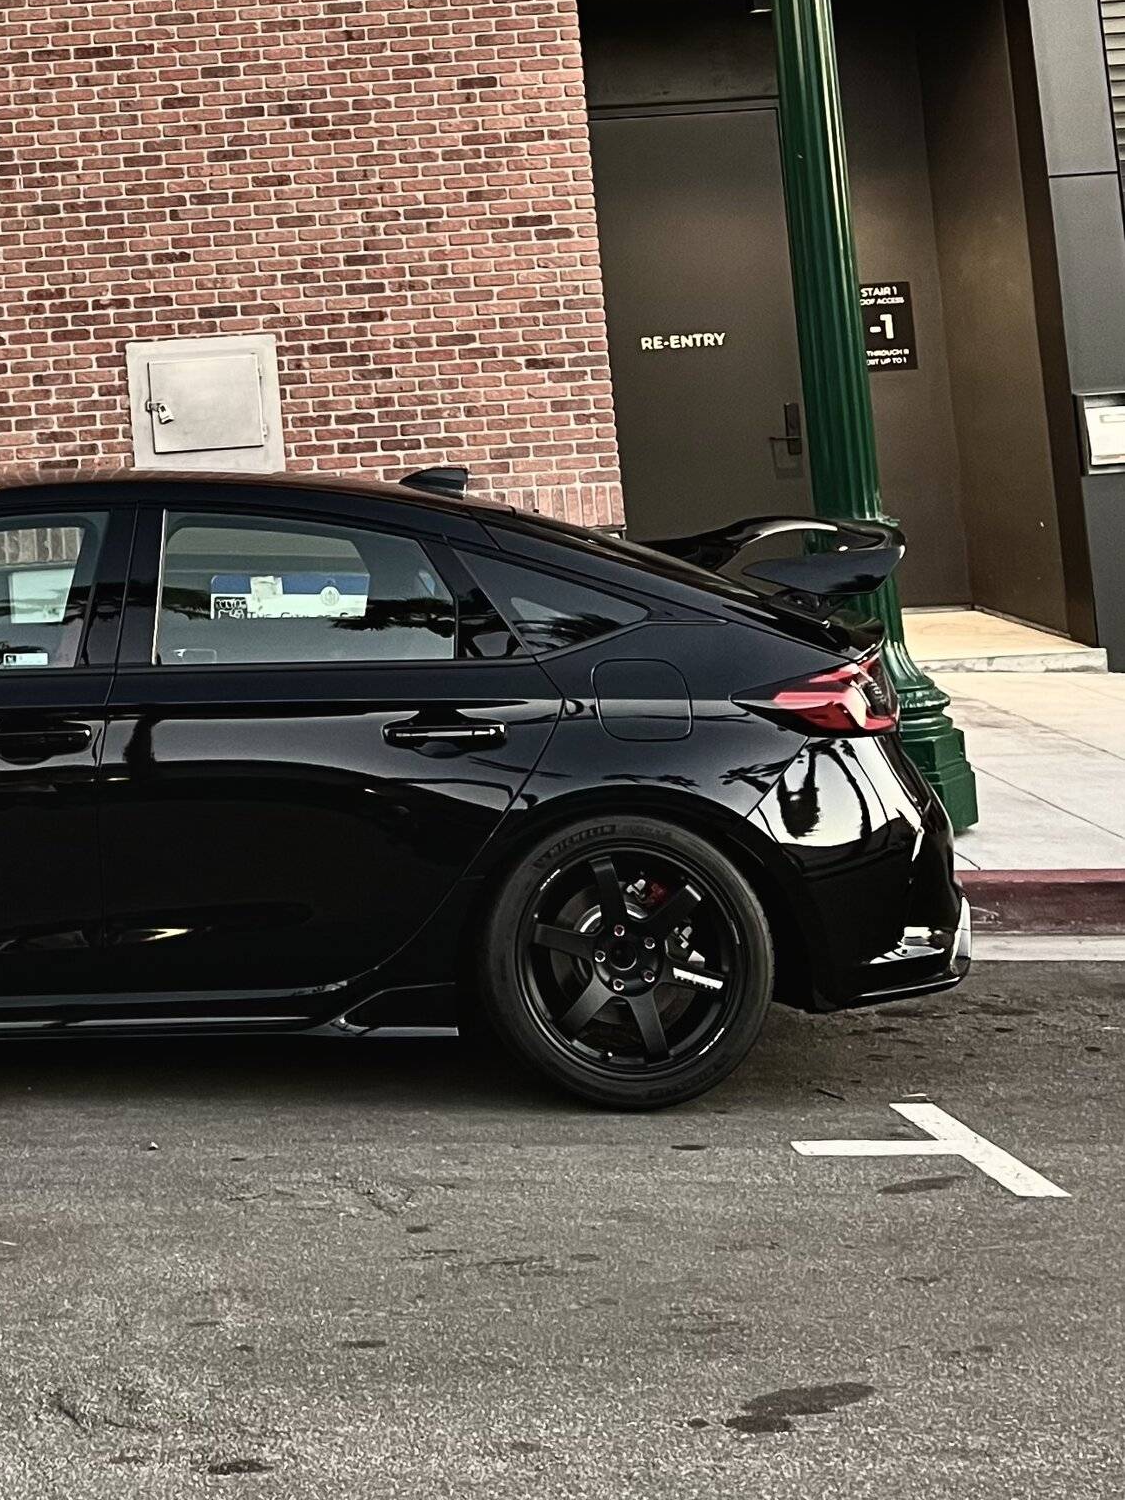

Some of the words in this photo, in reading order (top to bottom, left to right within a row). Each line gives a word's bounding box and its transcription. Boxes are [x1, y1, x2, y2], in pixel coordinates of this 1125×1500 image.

[860, 286, 891, 297] STAIR
[892, 286, 897, 295] 1
[869, 314, 894, 339] -1
[641, 333, 725, 350] RE-ENTRY
